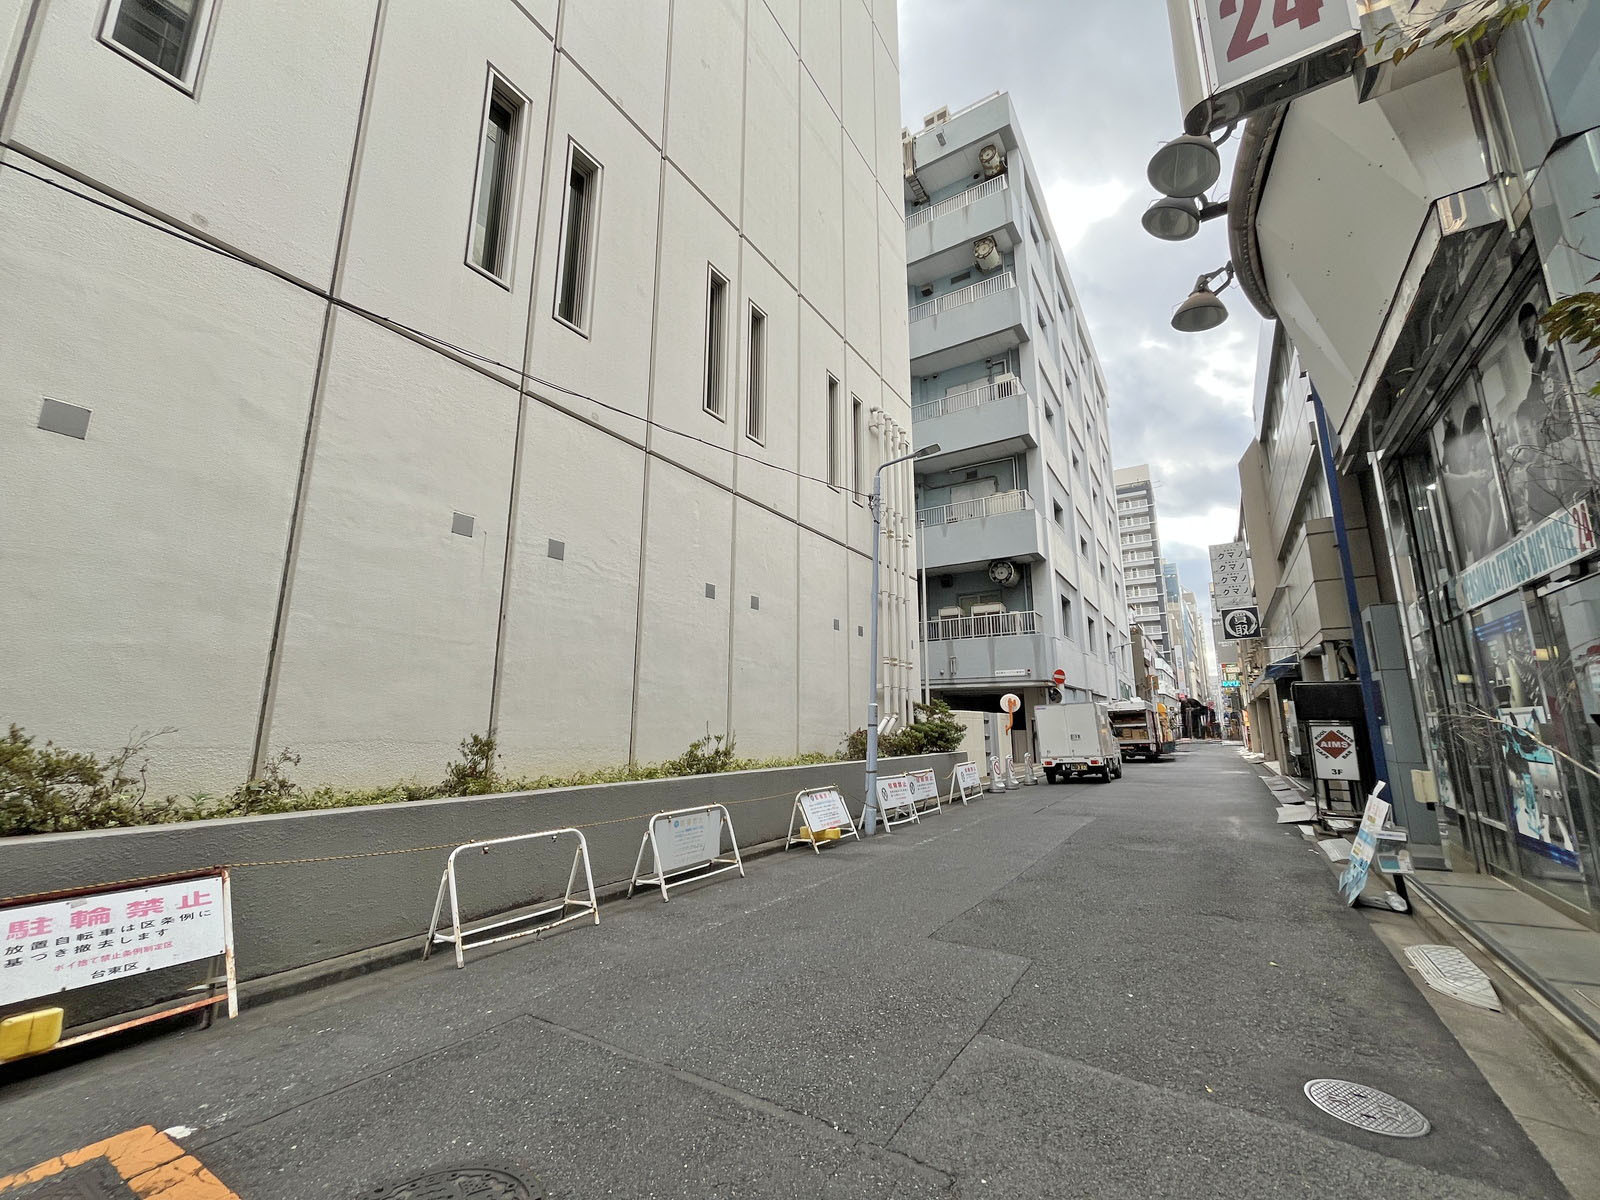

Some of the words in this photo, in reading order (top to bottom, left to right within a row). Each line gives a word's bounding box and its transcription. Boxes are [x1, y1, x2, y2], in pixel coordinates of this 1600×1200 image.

[1496, 540, 1530, 590] FITNESS
[1320, 741, 1349, 749] AIMS
[4, 910, 212, 956] 放置自転車は区条例に
[6, 891, 212, 940] 駐輪禁止
[4, 929, 168, 968] 基つき撤去します
[91, 962, 138, 979] 台東区
